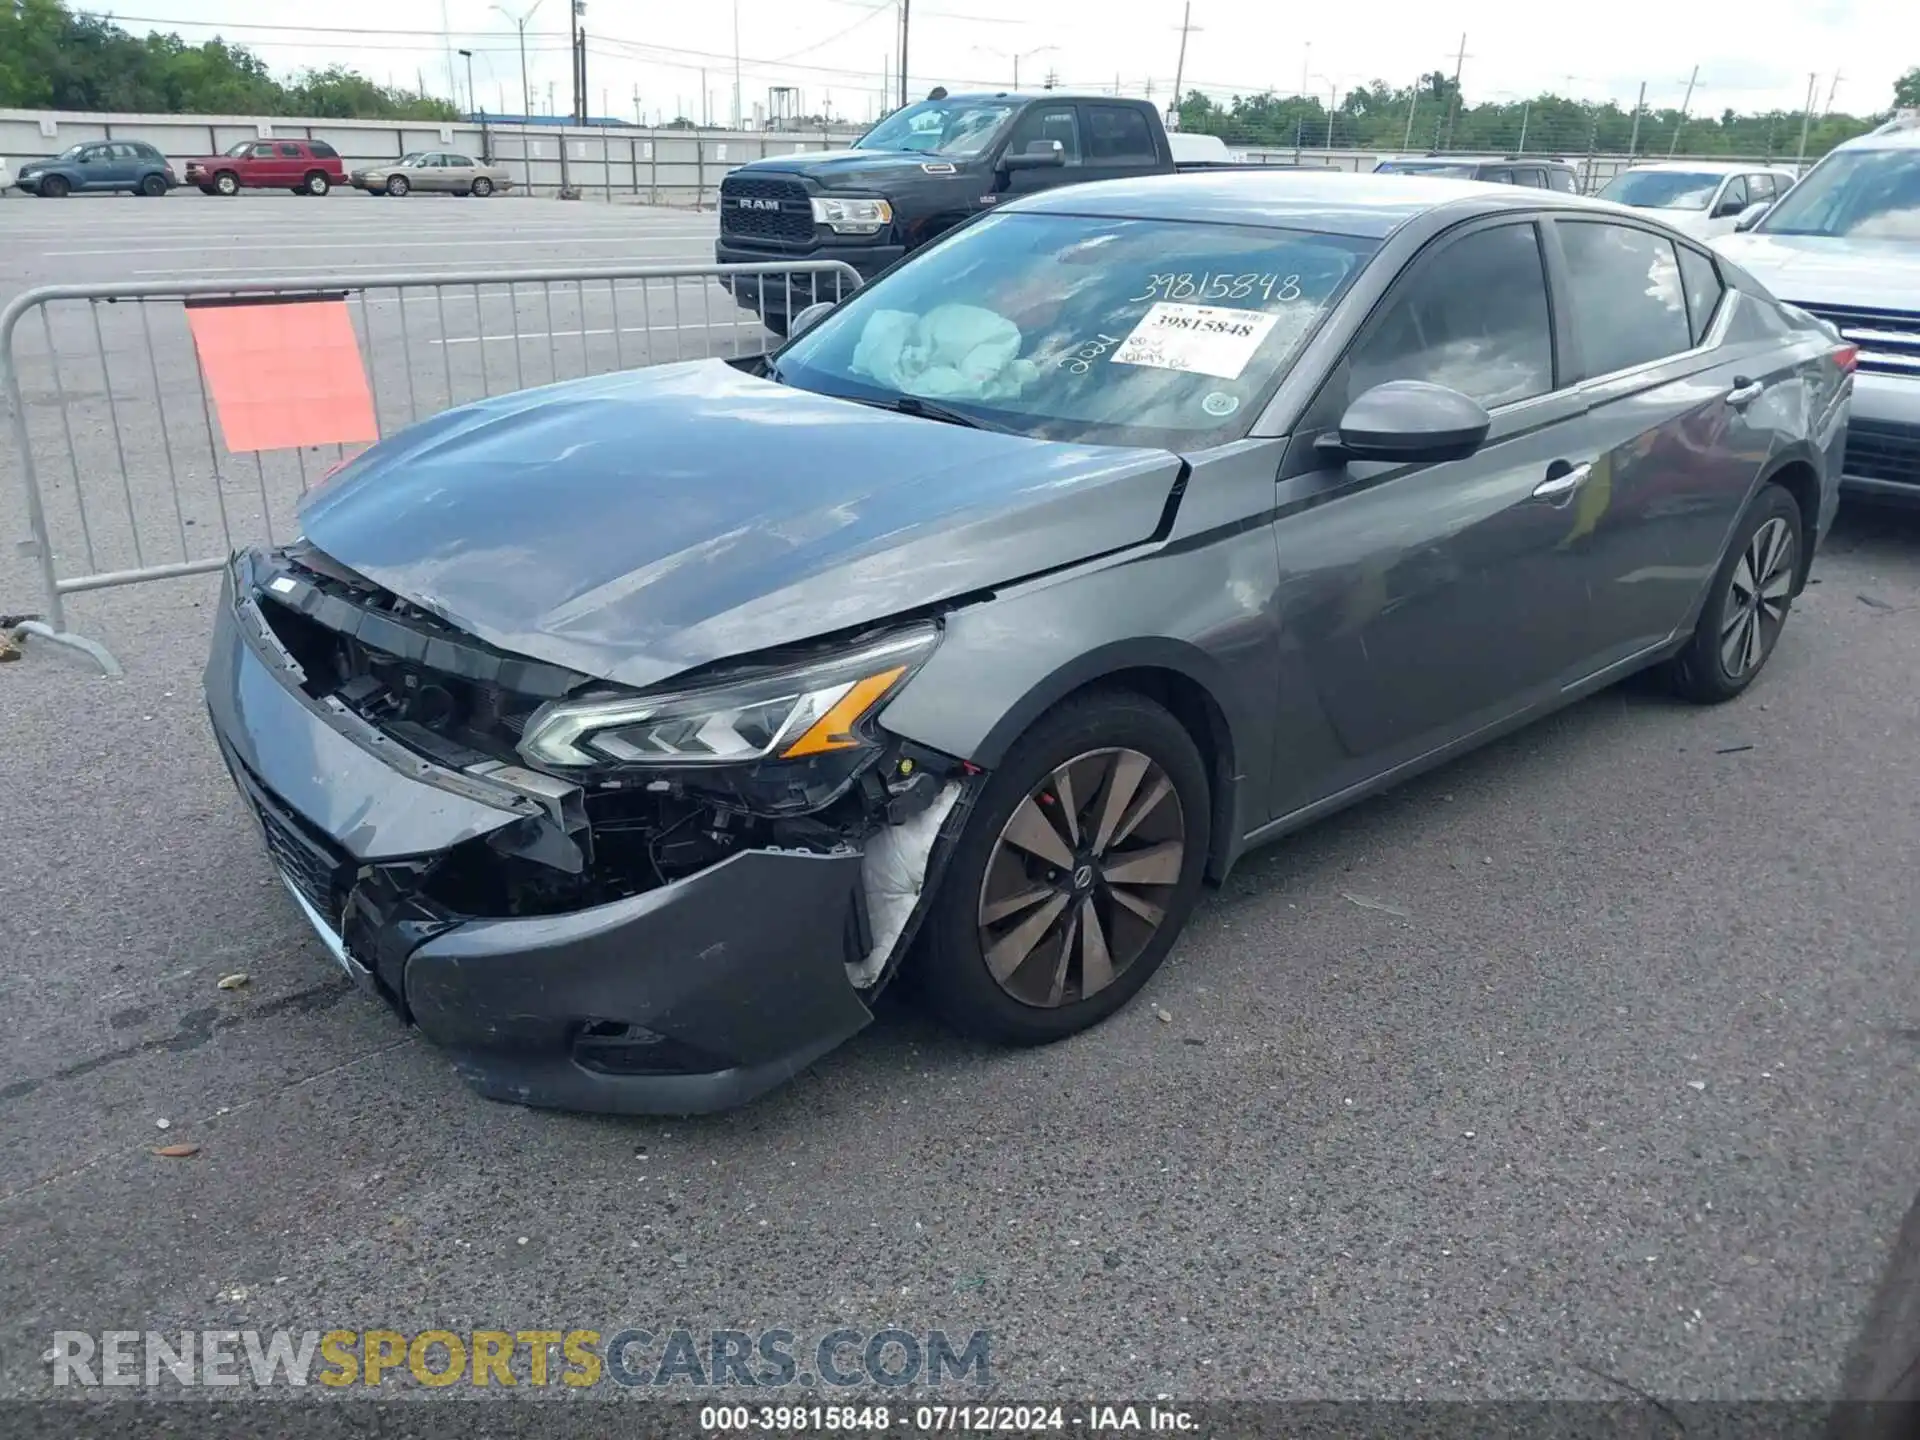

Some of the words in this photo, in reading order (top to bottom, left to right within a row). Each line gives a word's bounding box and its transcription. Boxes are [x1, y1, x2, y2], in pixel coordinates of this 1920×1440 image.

[740, 199, 780, 210] RAM
[1129, 272, 1301, 302] 39815848
[1153, 314, 1254, 337] 39815848
